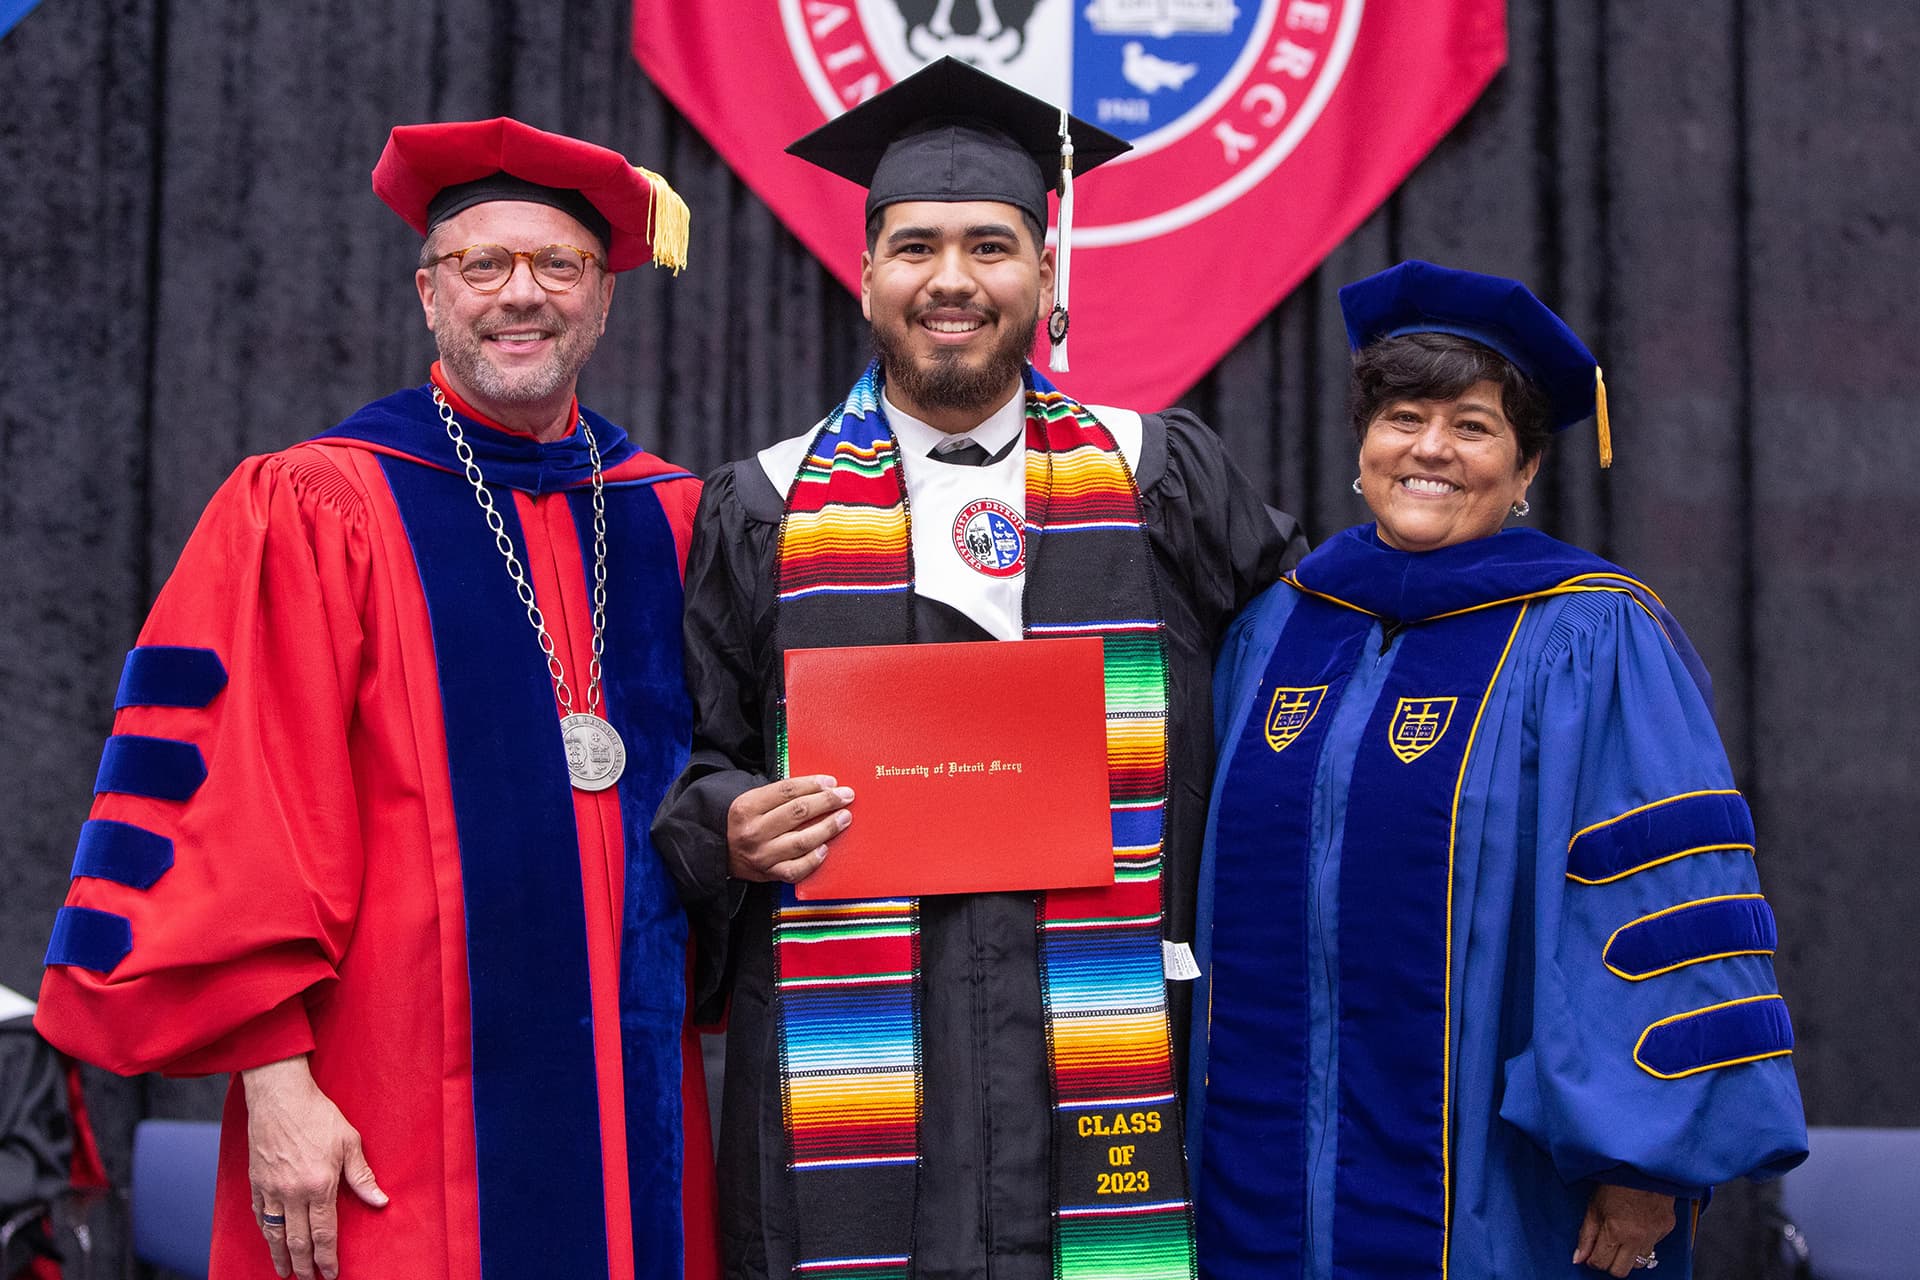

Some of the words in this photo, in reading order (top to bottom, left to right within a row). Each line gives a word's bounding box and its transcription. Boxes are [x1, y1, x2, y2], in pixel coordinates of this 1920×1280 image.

[956, 511, 982, 571] UNIVERSITY
[970, 502, 983, 513] OF
[986, 502, 1026, 531] DETROIT
[875, 765, 928, 779] University
[934, 763, 944, 774] of
[948, 762, 985, 777] Detroit
[988, 760, 1022, 774] Mercy
[1078, 1111, 1162, 1137] CLASS
[1108, 1145, 1136, 1167] OF
[1096, 1170, 1150, 1195] 2023
